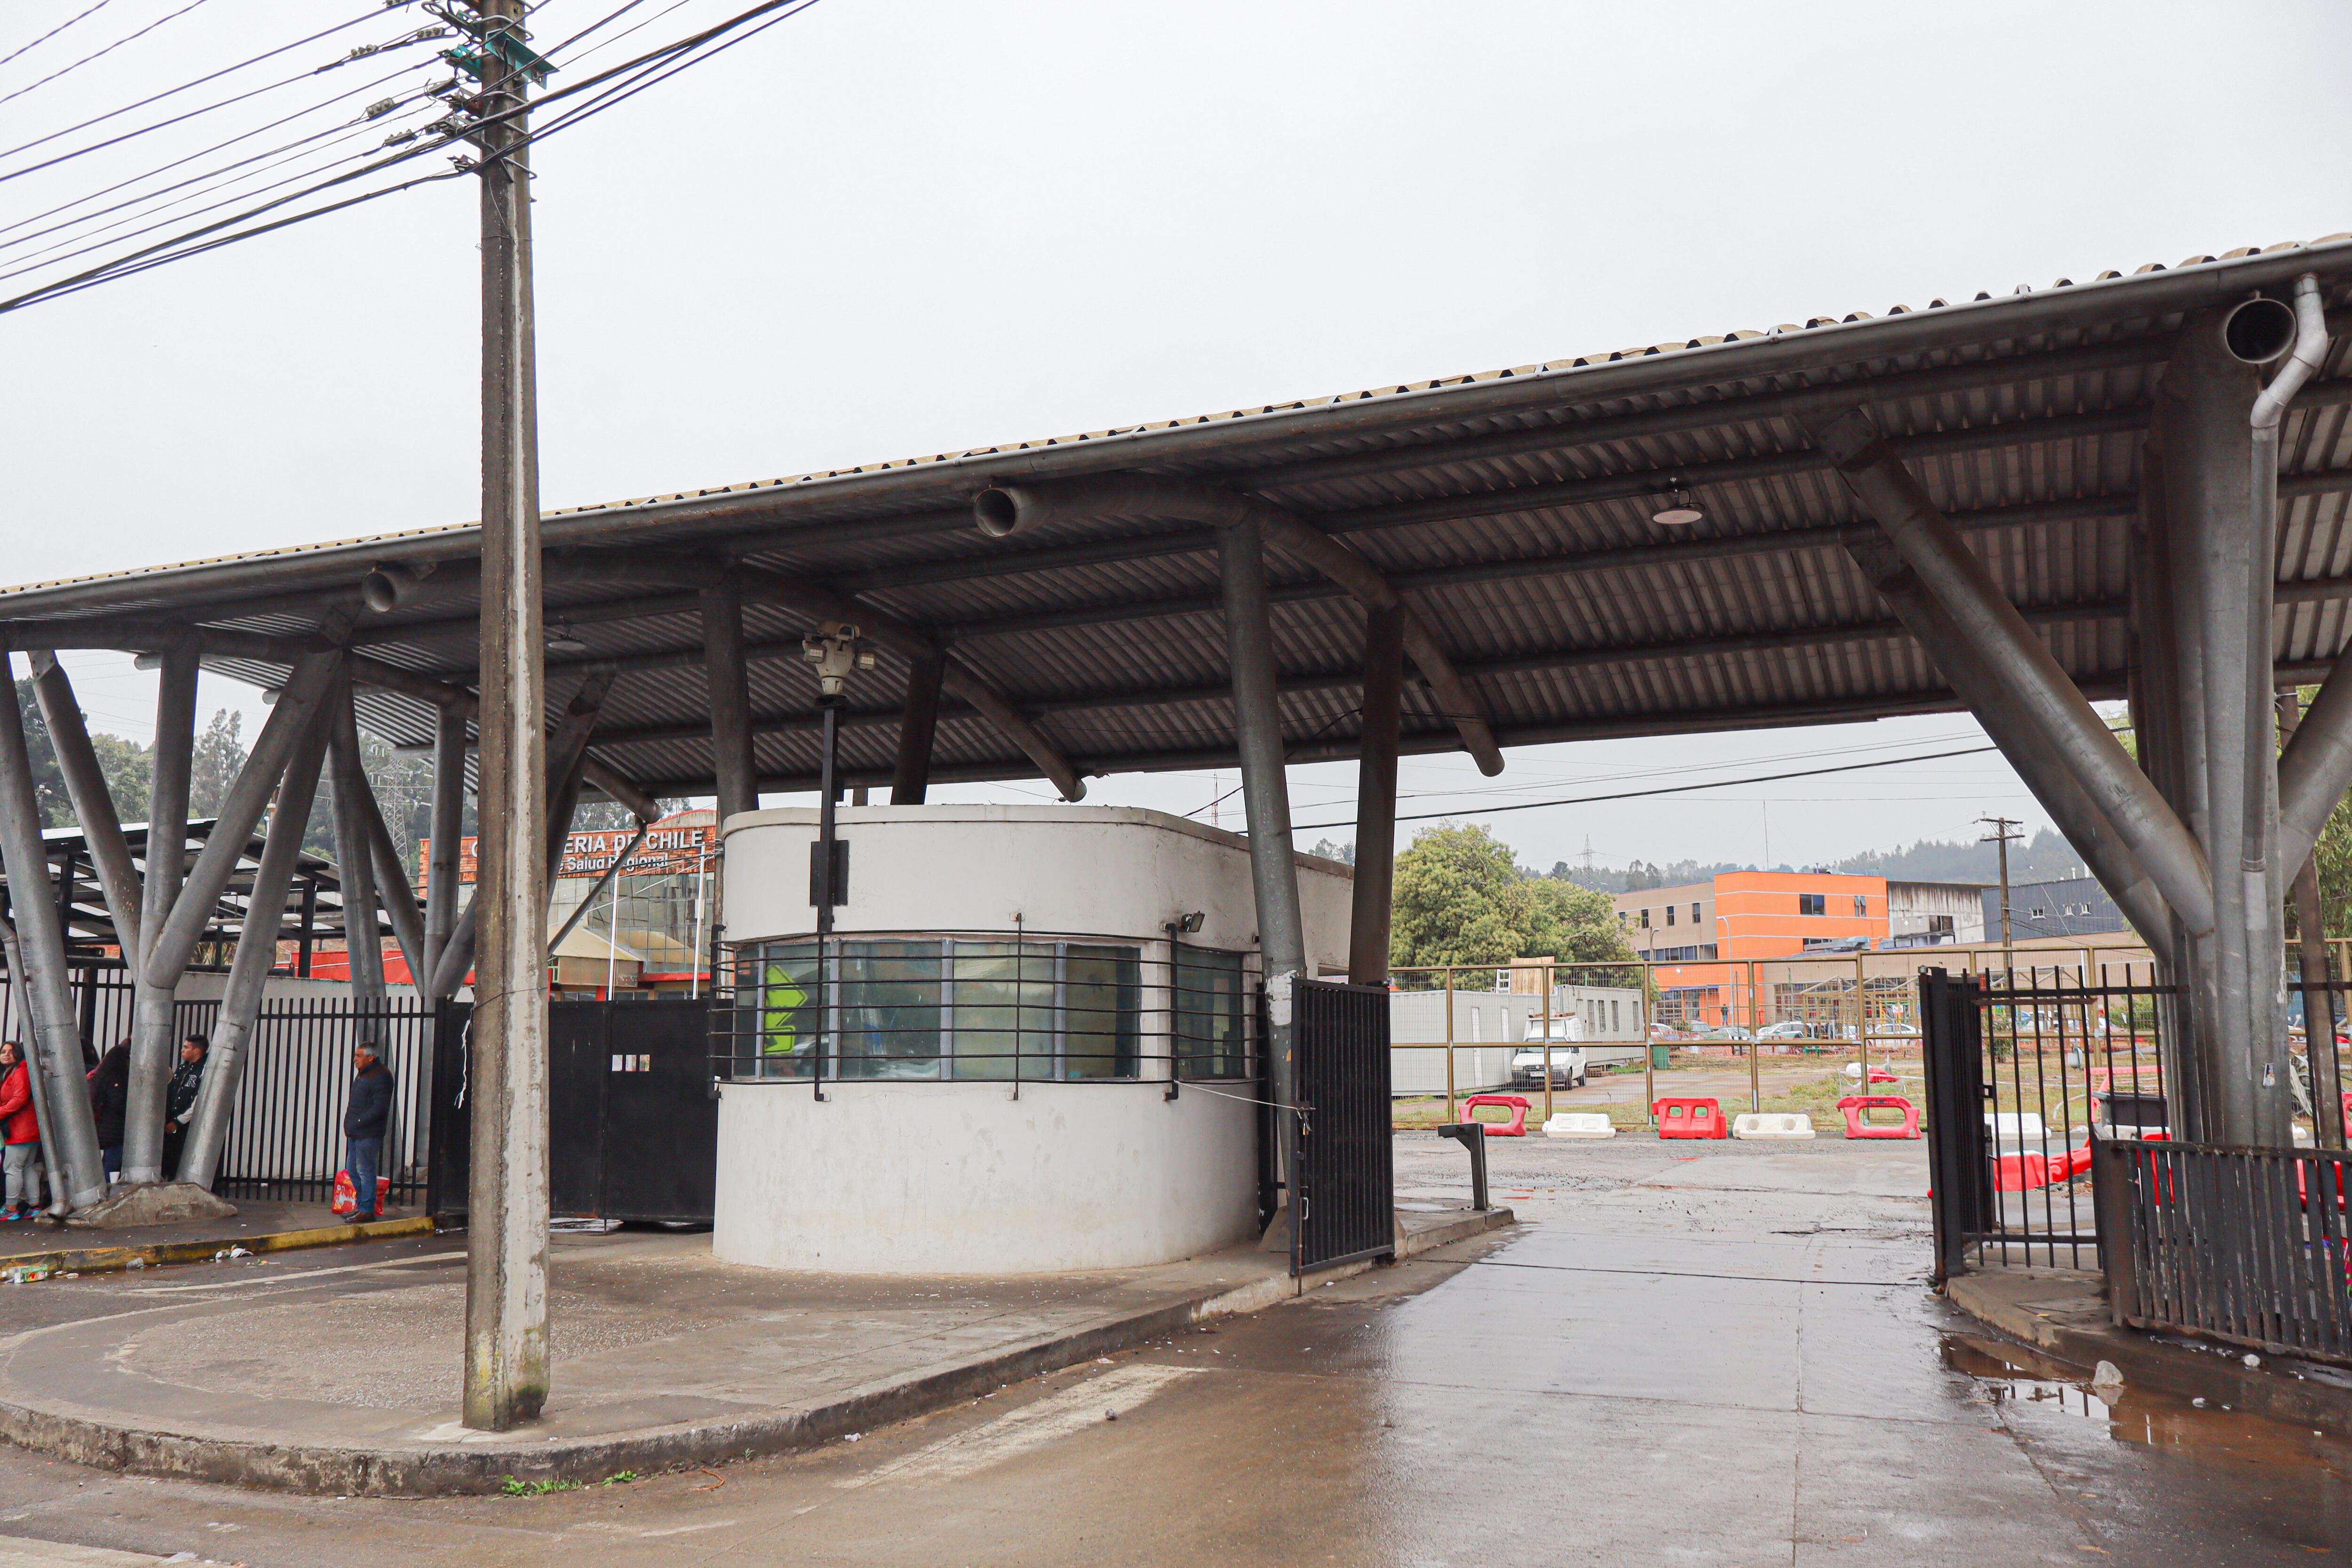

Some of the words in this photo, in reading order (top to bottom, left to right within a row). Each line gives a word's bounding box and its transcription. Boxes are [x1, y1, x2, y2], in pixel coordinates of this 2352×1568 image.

[646, 830, 703, 850] CHILE
[567, 855, 605, 871] Salud
[608, 852, 668, 872] Rgional
[184, 1074, 197, 1087] R
